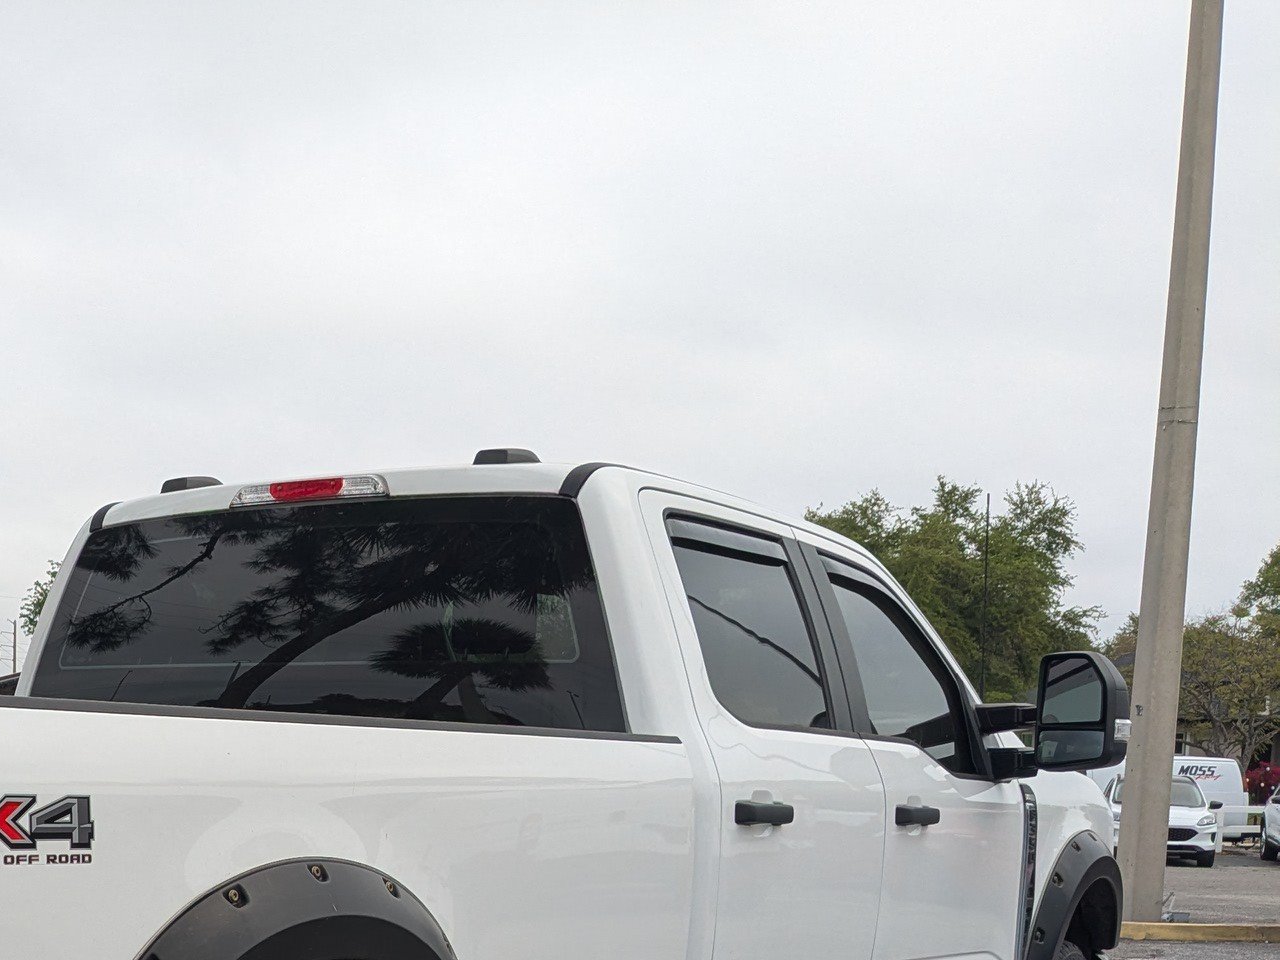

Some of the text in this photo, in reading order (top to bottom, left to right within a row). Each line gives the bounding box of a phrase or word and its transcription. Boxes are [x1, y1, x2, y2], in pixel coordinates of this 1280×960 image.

[1178, 765, 1217, 776] MOSS
[3, 853, 93, 865] OFF ROAD
